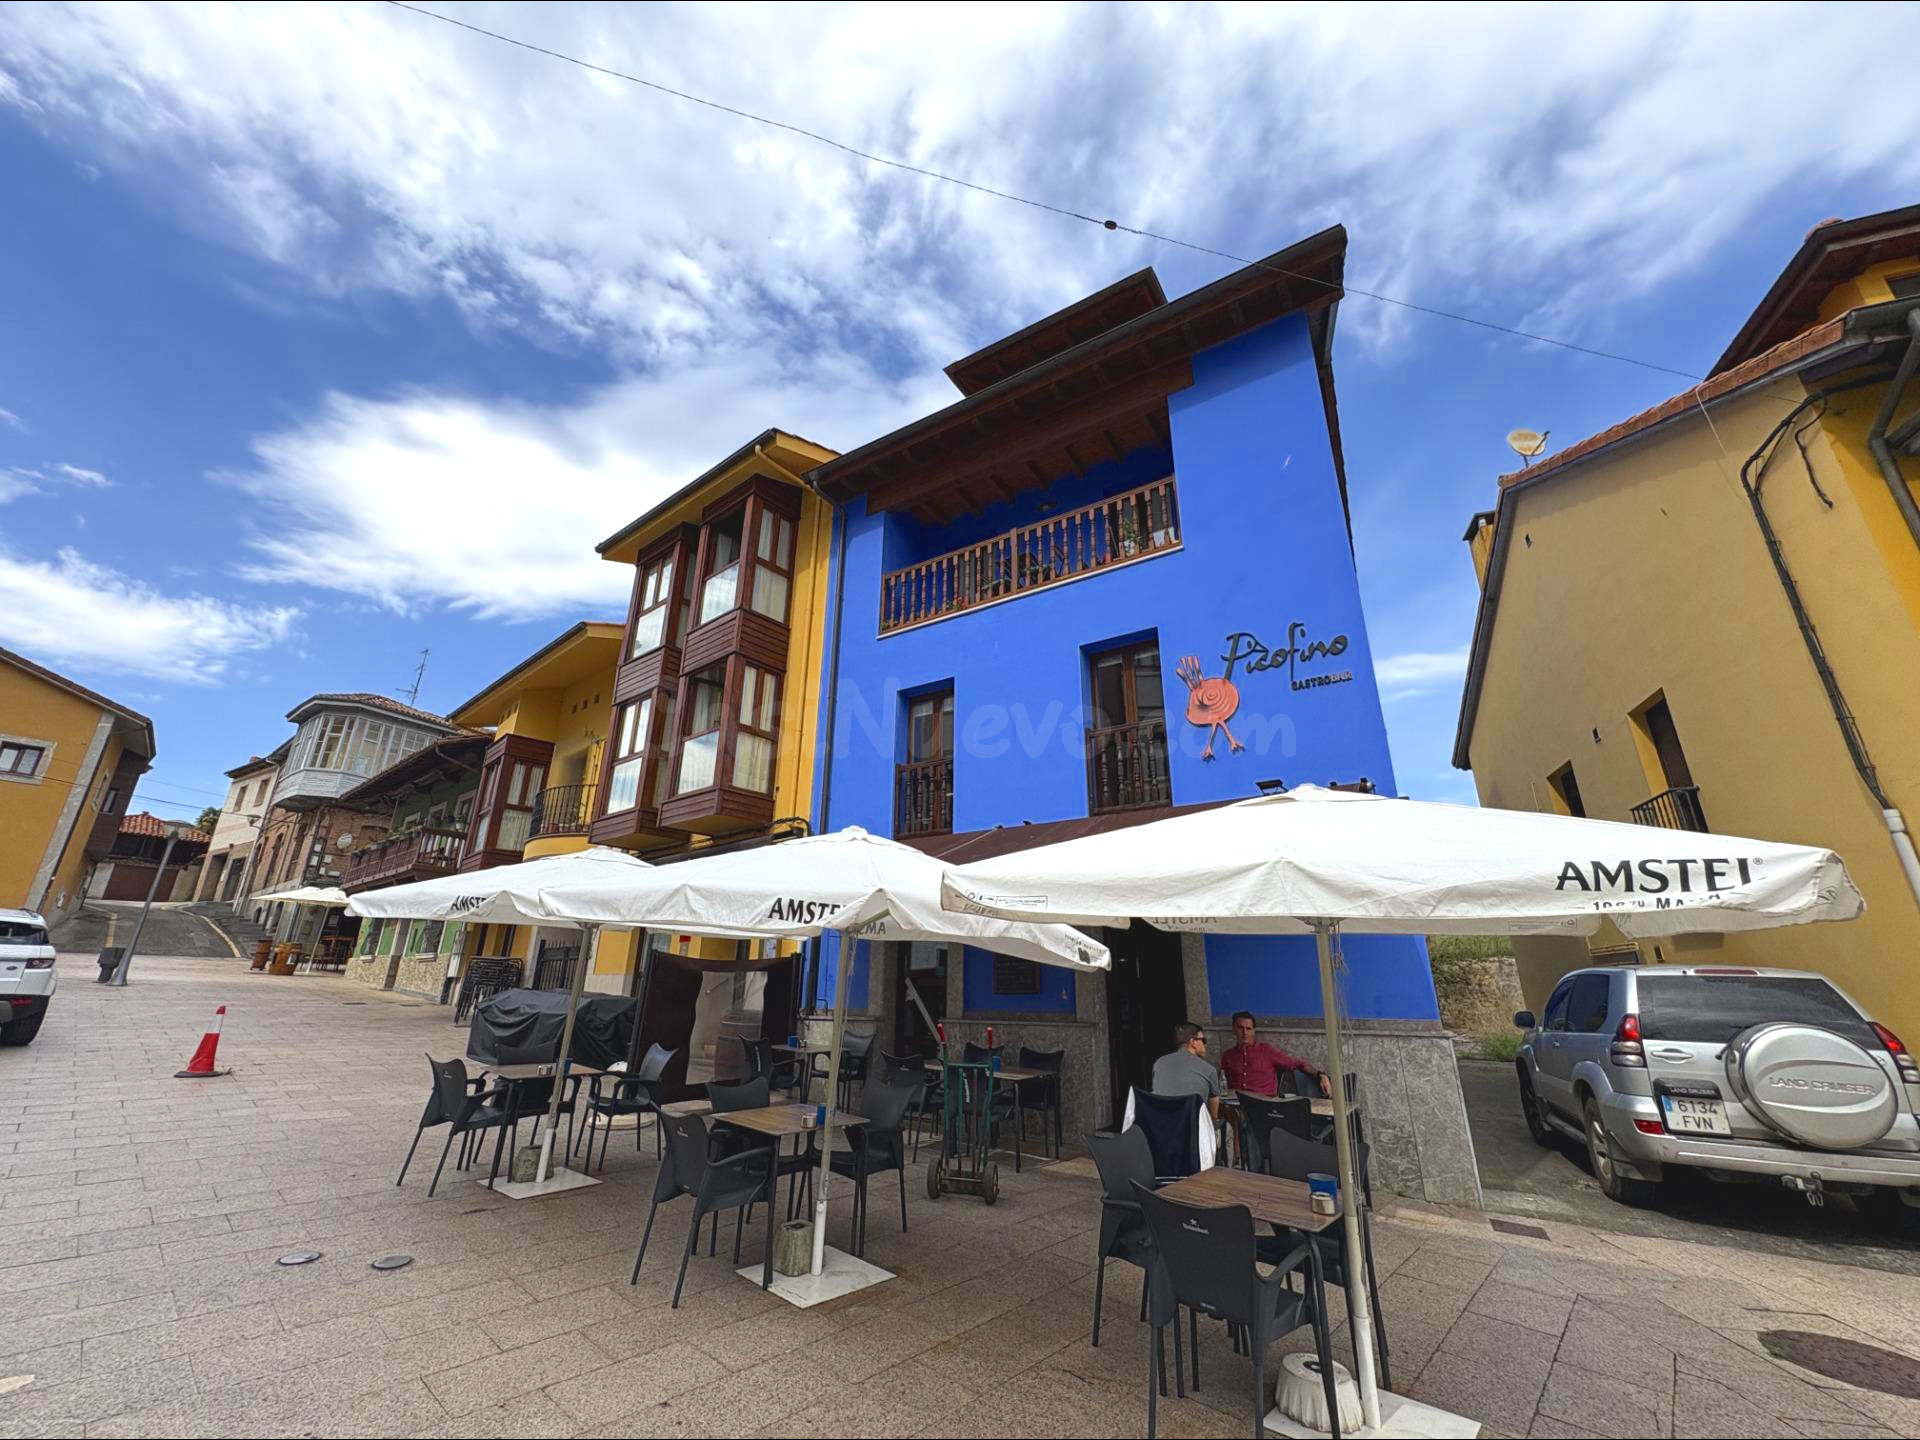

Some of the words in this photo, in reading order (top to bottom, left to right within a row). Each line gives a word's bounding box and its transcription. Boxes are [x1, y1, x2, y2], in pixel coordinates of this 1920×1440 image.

[1220, 622, 1348, 682] Picofino
[768, 897, 846, 925] AMSTE
[1677, 1100, 1718, 1115] 6134
[1682, 1115, 1714, 1130] FVN
